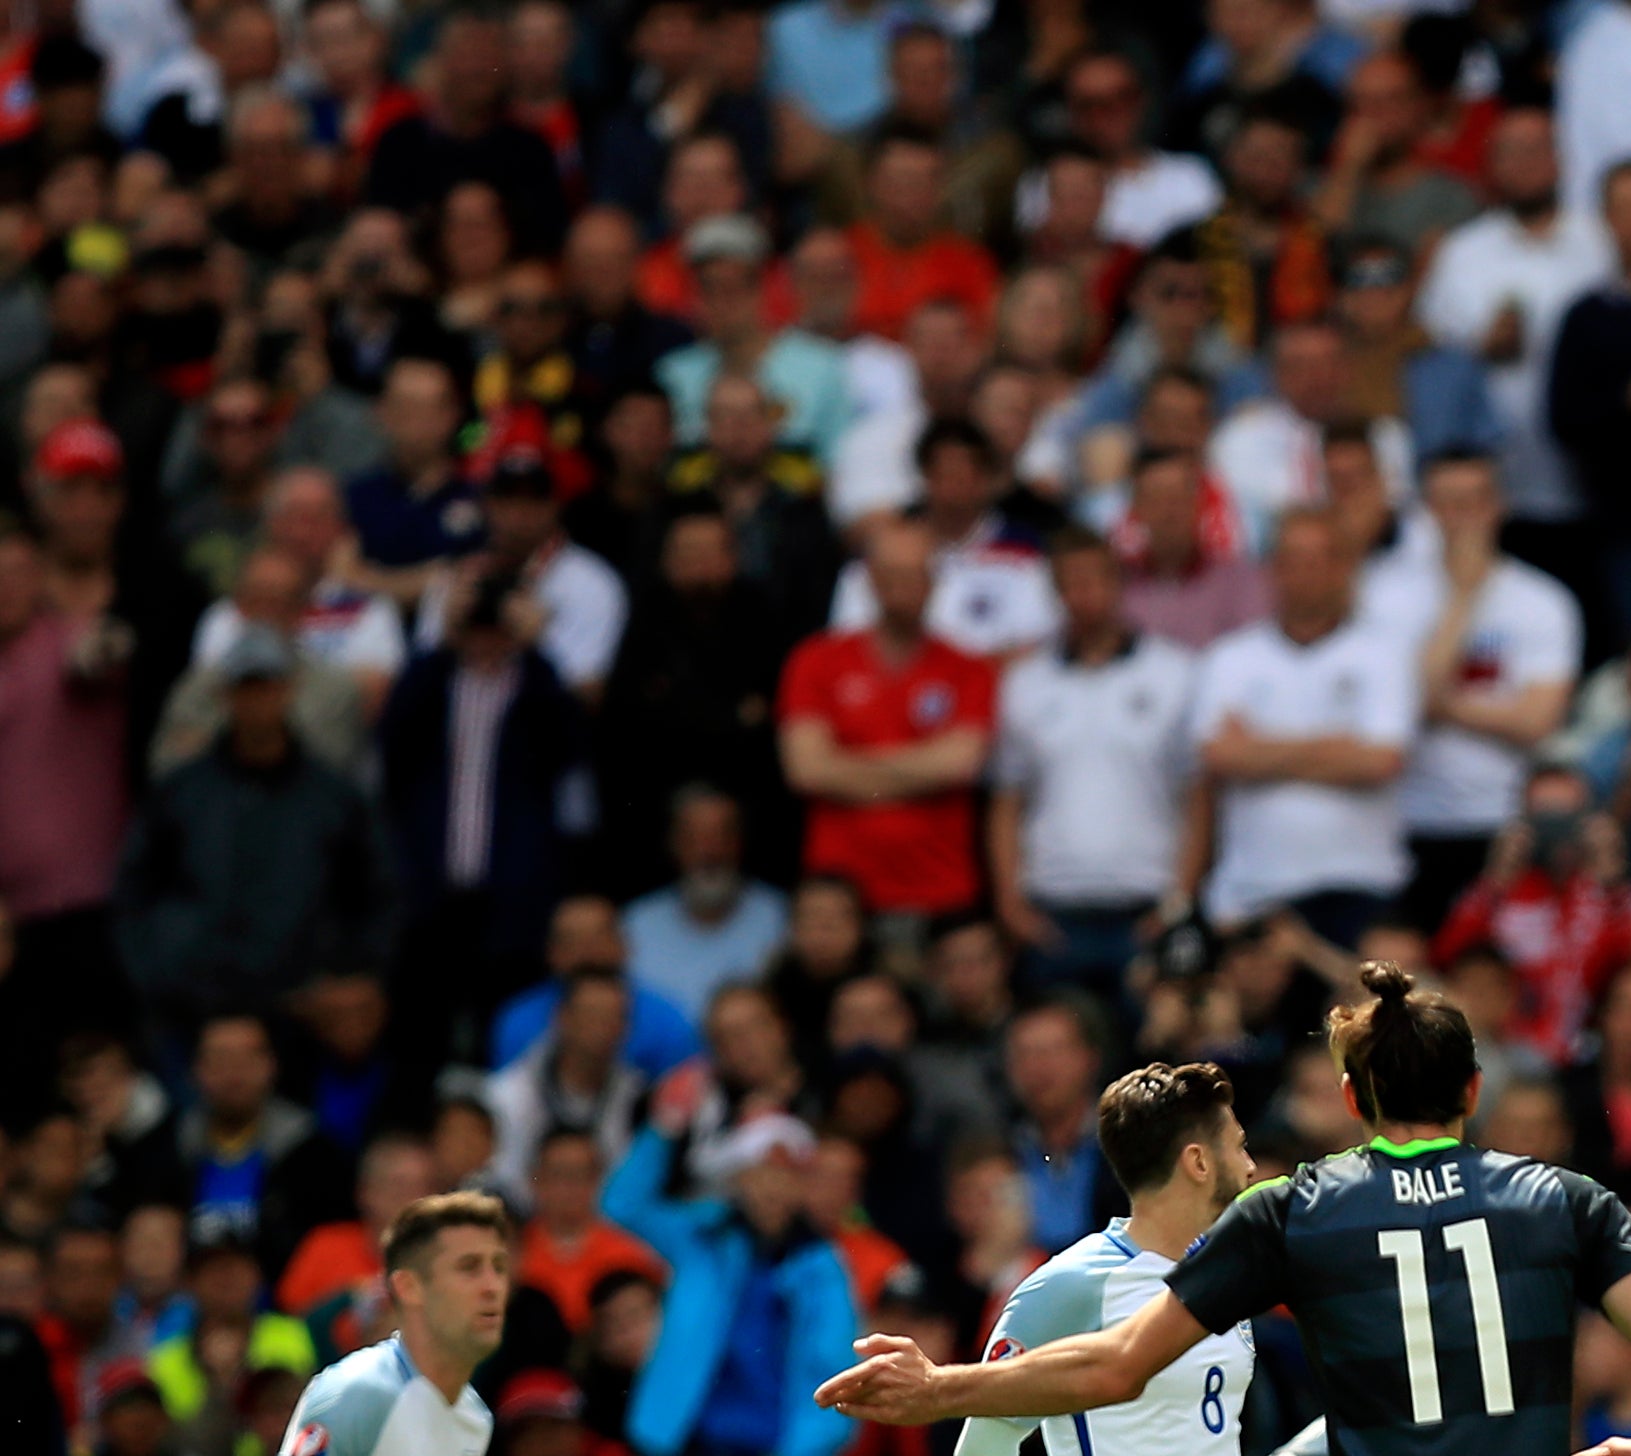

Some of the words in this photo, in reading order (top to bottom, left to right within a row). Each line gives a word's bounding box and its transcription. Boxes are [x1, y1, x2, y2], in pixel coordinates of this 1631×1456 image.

[1391, 1162, 1465, 1206] BALE
[1378, 1217, 1515, 1425] 11
[1202, 1365, 1224, 1435] 8
